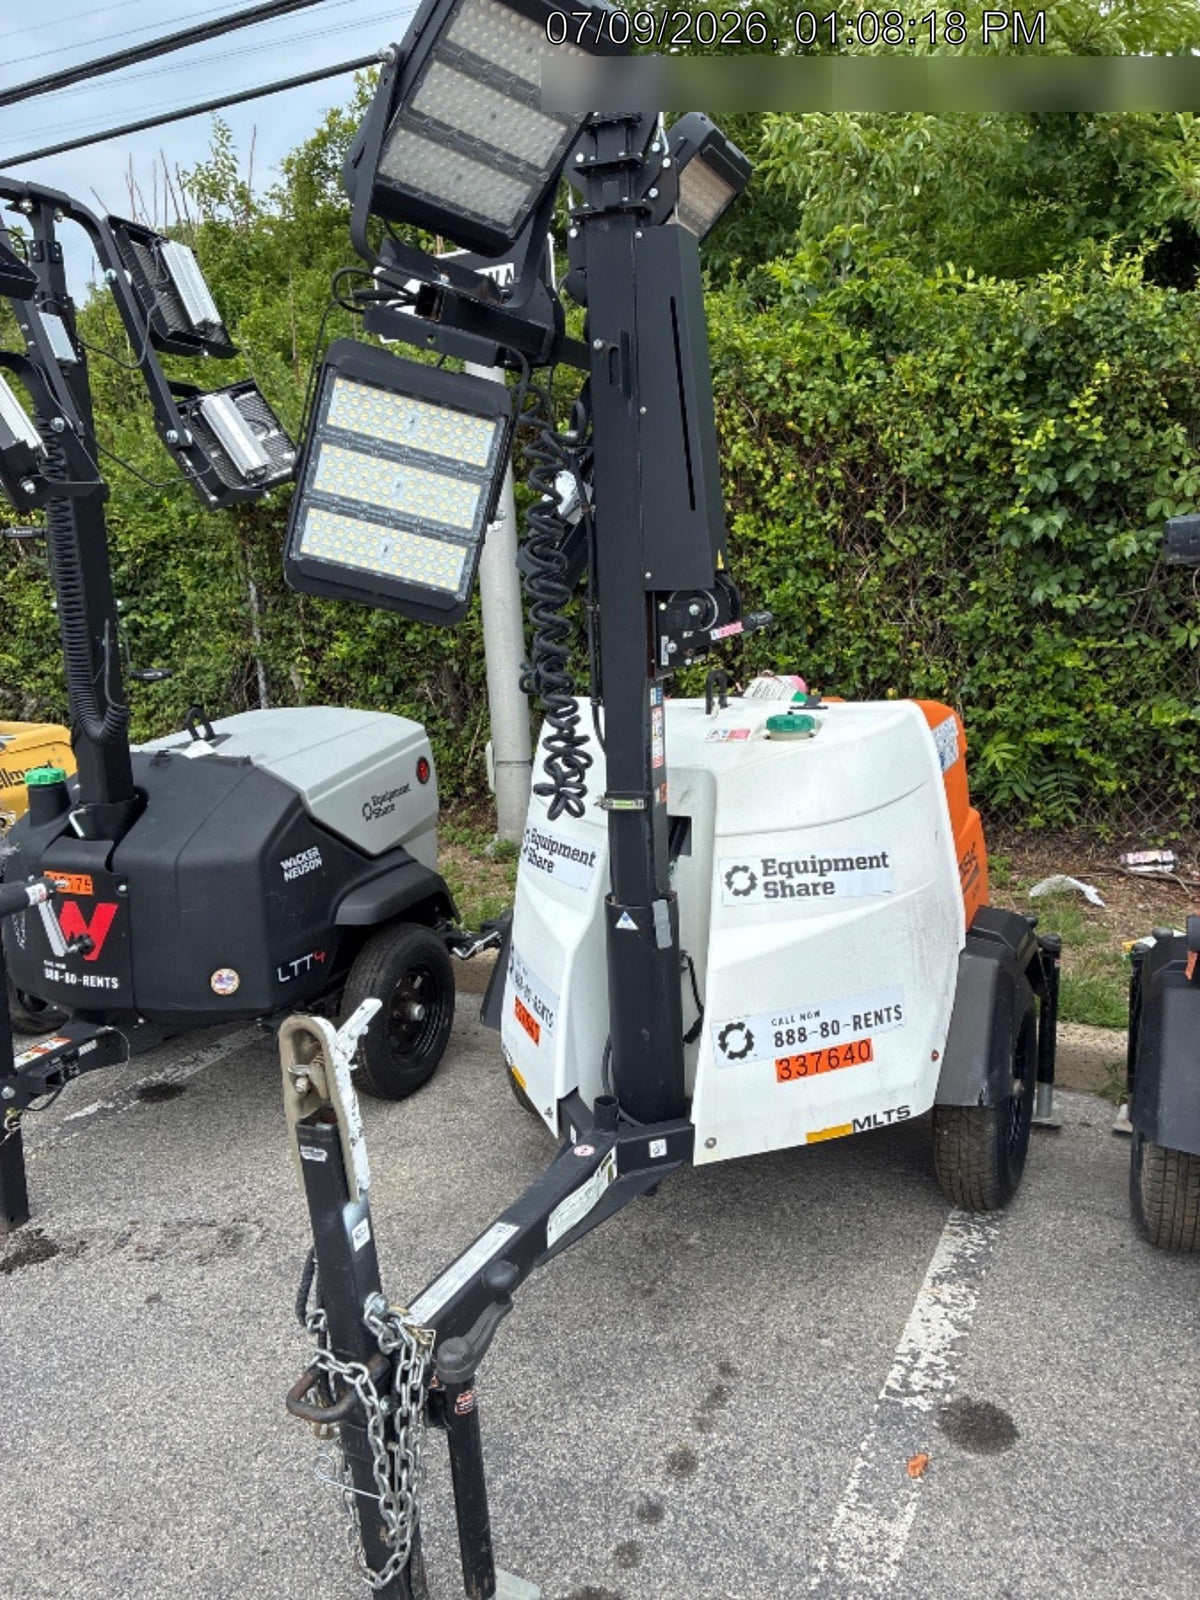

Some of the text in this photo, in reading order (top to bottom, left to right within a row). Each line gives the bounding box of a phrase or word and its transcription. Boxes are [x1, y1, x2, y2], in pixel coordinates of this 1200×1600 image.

[284, 857, 322, 882] NEUSON
[761, 851, 889, 879] Equipment
[763, 880, 836, 899] Share
[771, 1009, 821, 1027] CALL NOW
[774, 1004, 902, 1048] 888-80-RENTS
[778, 1039, 871, 1080] 337640
[851, 1104, 911, 1134] MLTS
